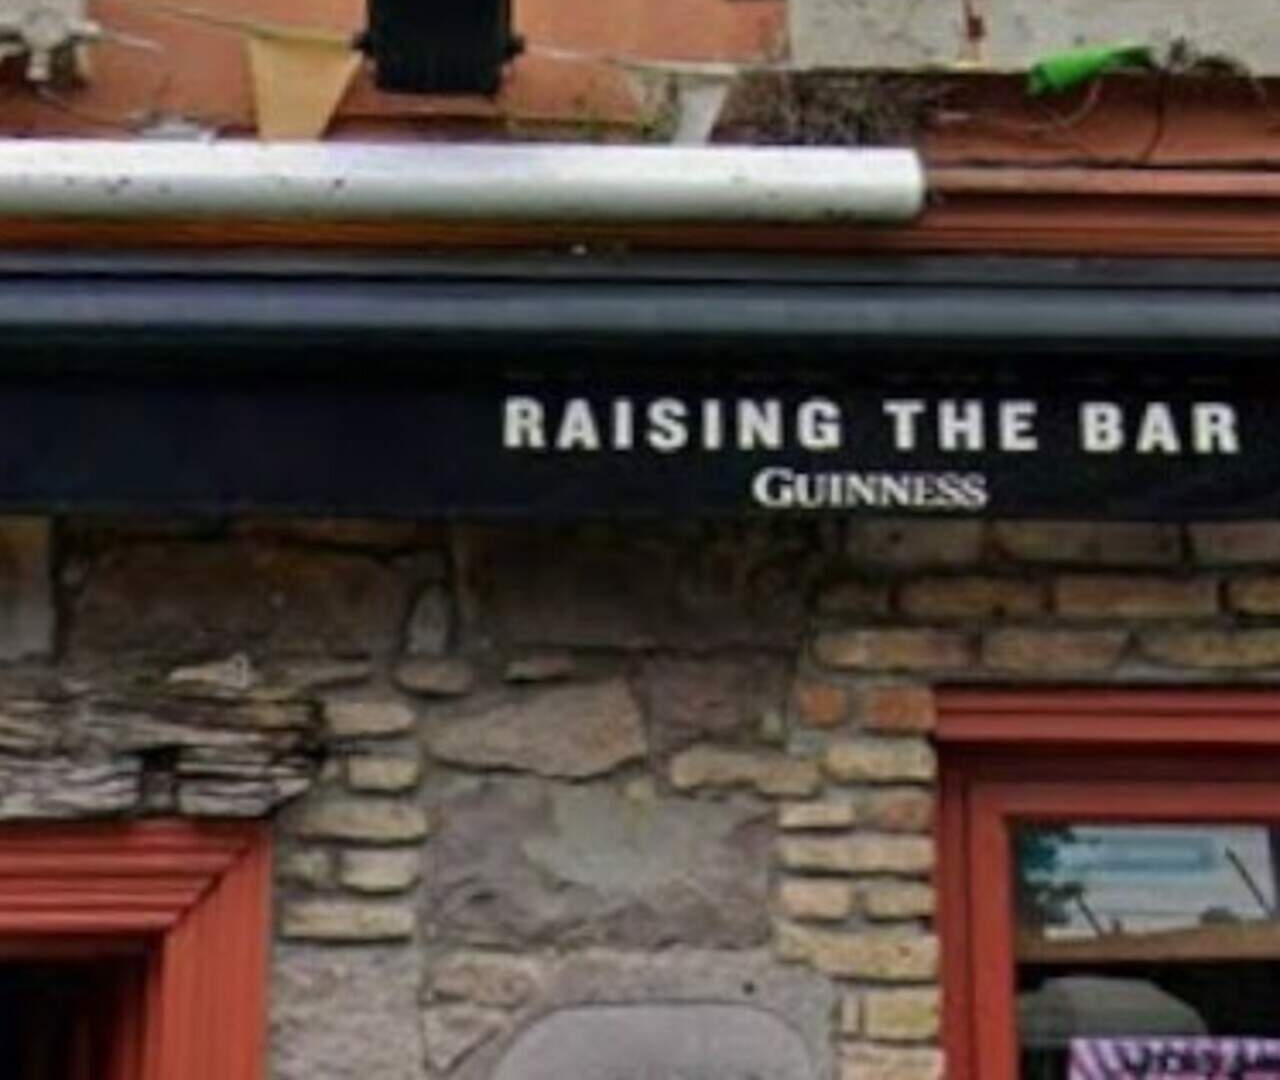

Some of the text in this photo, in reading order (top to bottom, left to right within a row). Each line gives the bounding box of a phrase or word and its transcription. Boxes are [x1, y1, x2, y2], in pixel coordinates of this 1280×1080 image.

[503, 397, 1240, 454] RAISING THE BAR
